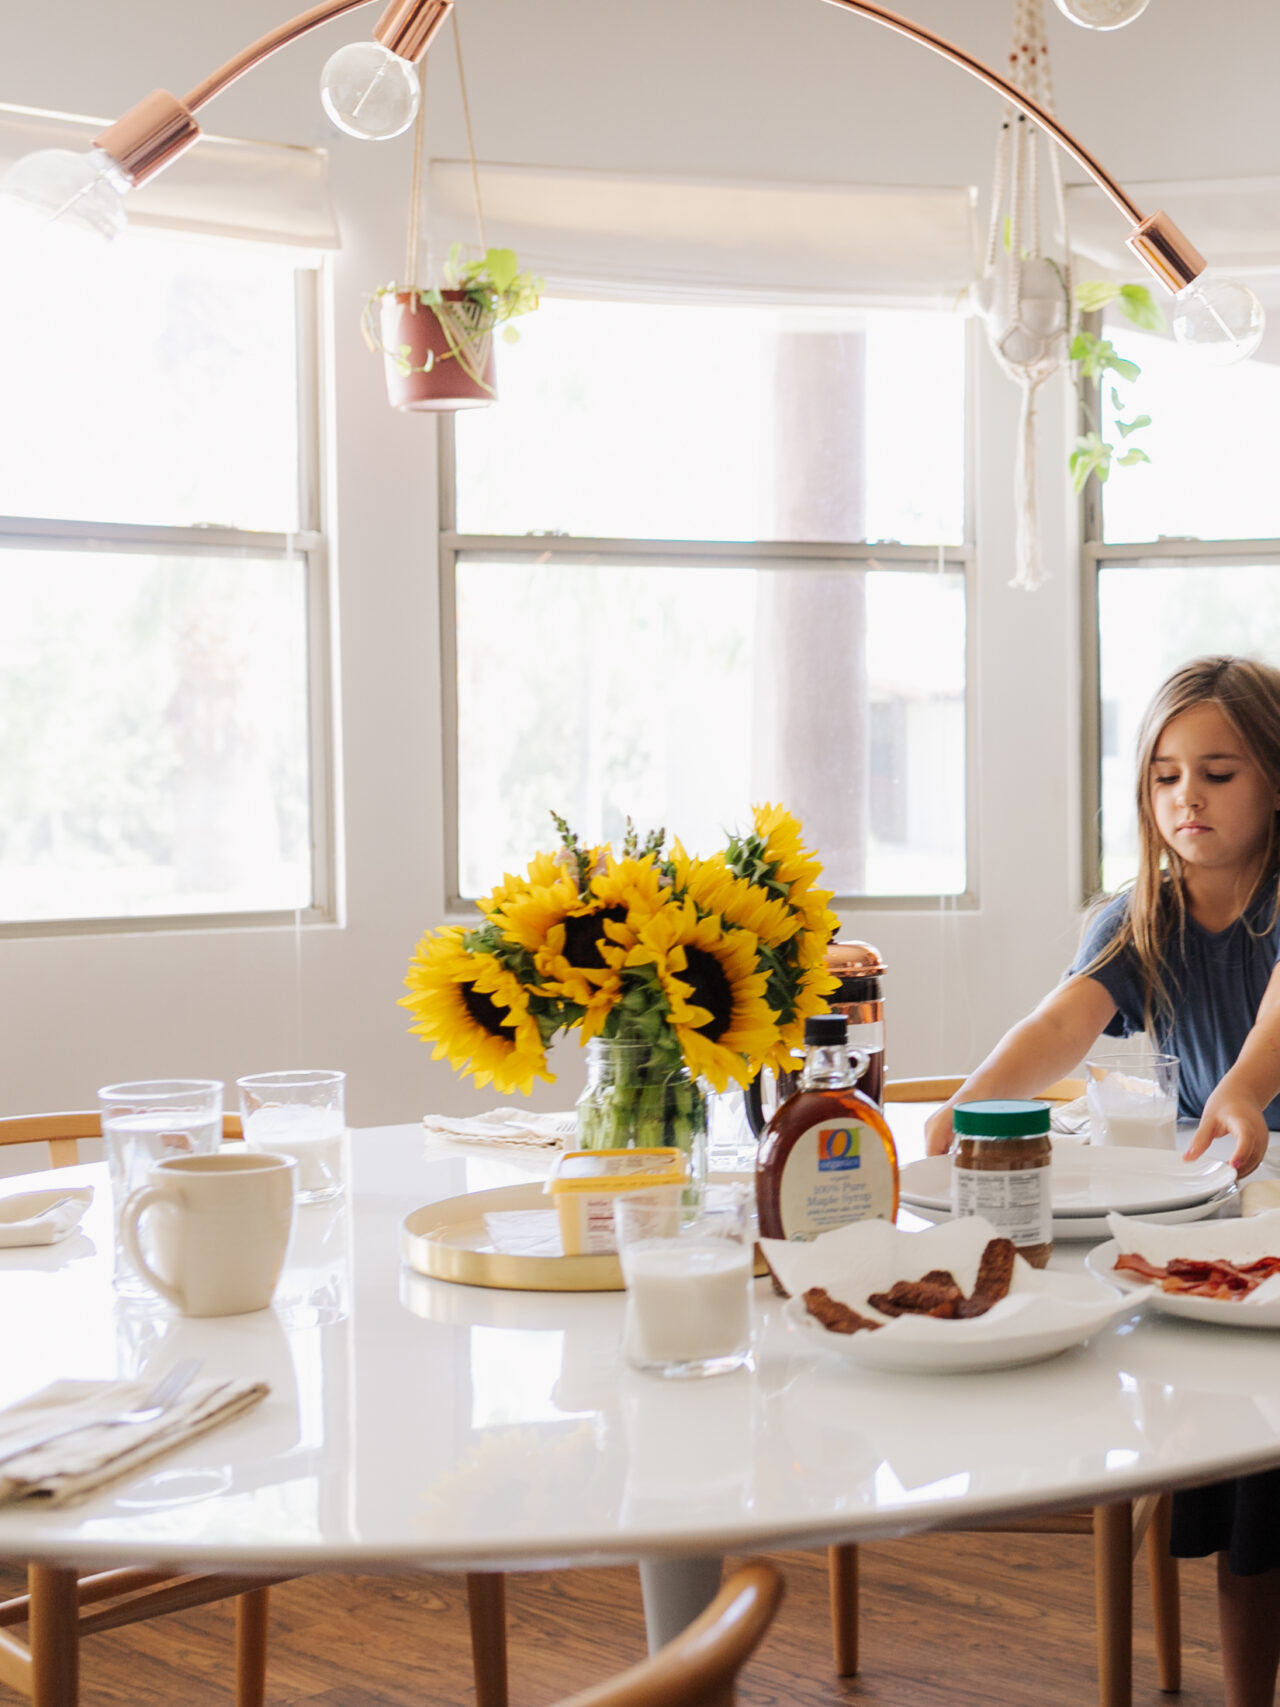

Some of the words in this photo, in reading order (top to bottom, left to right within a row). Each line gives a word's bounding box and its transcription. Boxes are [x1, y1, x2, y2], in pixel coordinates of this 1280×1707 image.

[814, 1185, 839, 1194] 100%
[843, 1182, 866, 1191] Pure
[807, 1197, 838, 1207] Maple
[843, 1194, 871, 1204] Syrup
